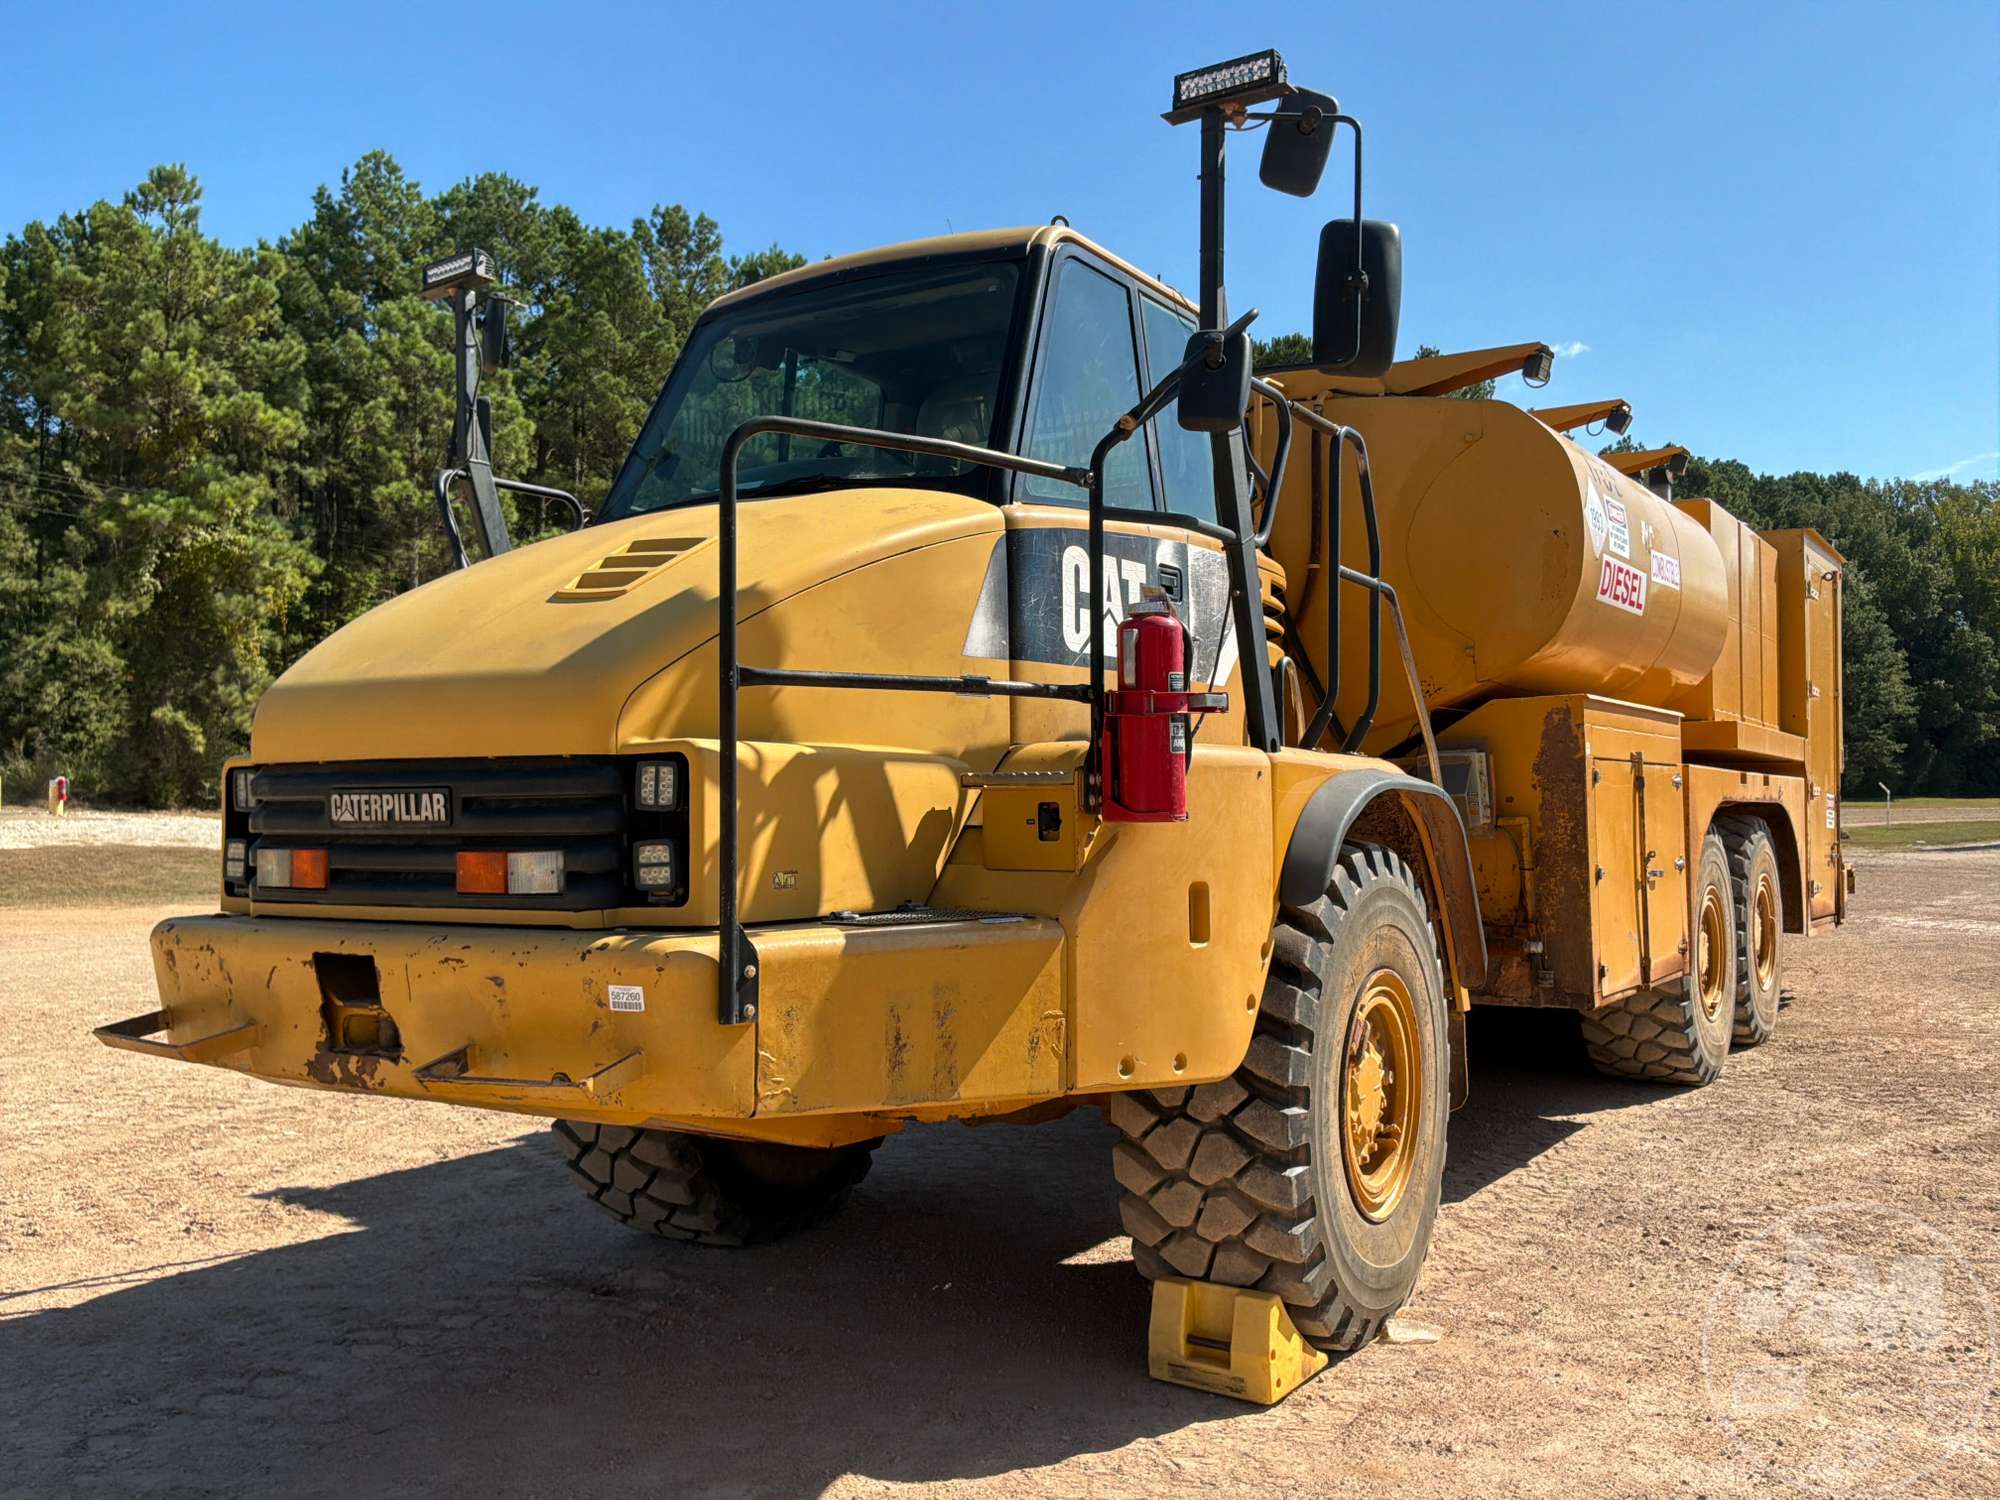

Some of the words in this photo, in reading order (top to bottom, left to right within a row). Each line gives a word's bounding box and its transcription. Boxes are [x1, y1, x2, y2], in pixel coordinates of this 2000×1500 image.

[1062, 545, 1147, 657] CAT
[1599, 559, 1643, 611] DIESEL
[330, 792, 446, 823] CATERPILLAR
[611, 991, 641, 1001] 587260
